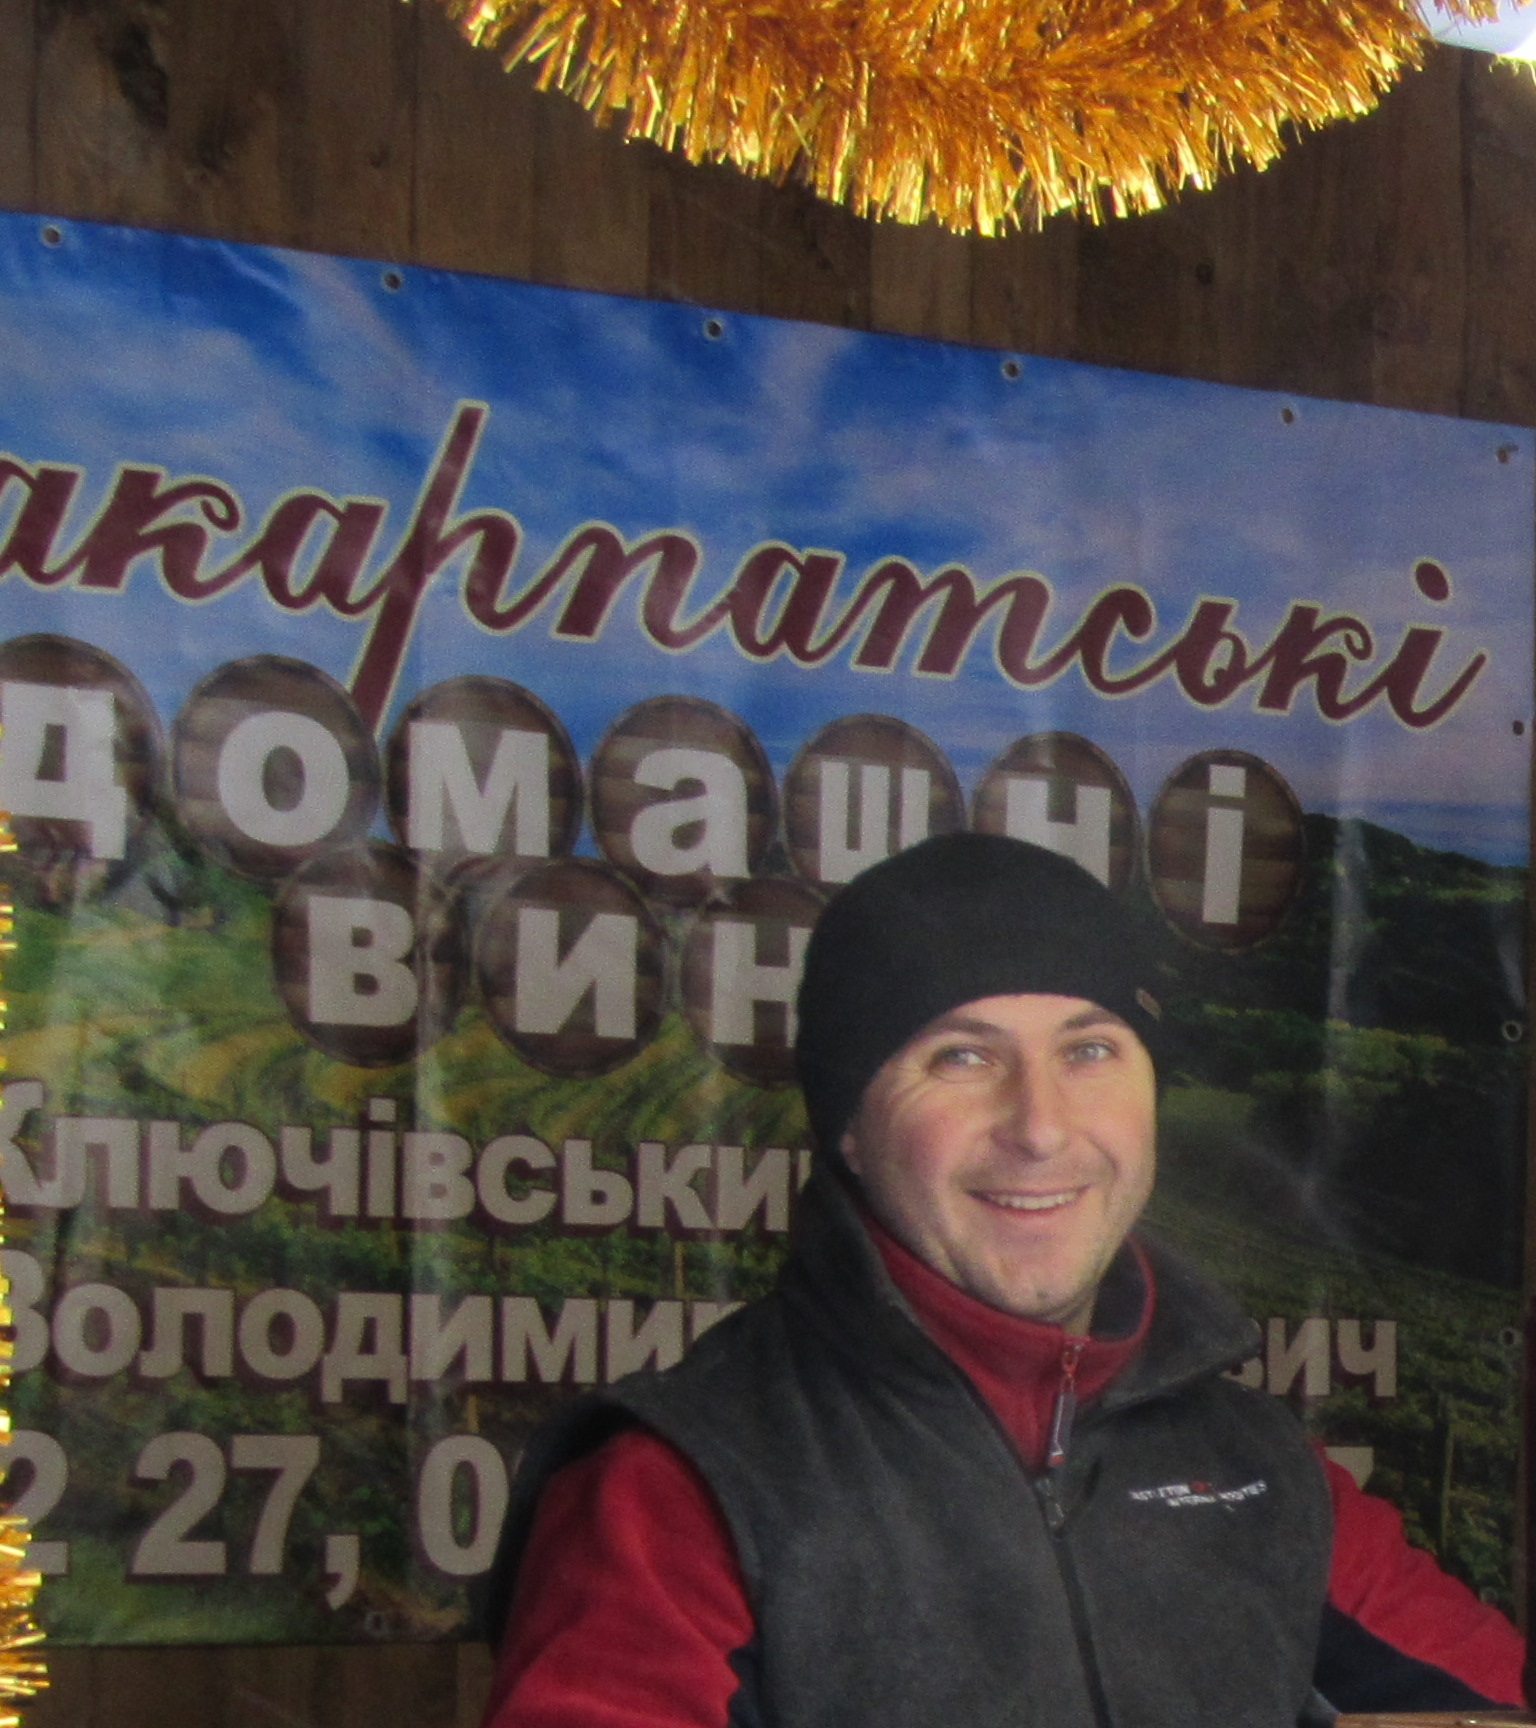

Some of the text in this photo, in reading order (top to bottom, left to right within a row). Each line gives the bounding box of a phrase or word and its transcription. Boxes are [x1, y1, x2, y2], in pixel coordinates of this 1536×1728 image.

[0, 681, 1247, 925] домашні
[0, 1079, 812, 1232] Ключівськи
[0, 1249, 746, 1404] Володими
[131, 1432, 361, 1611] 27,
[418, 1434, 526, 1578] 0
